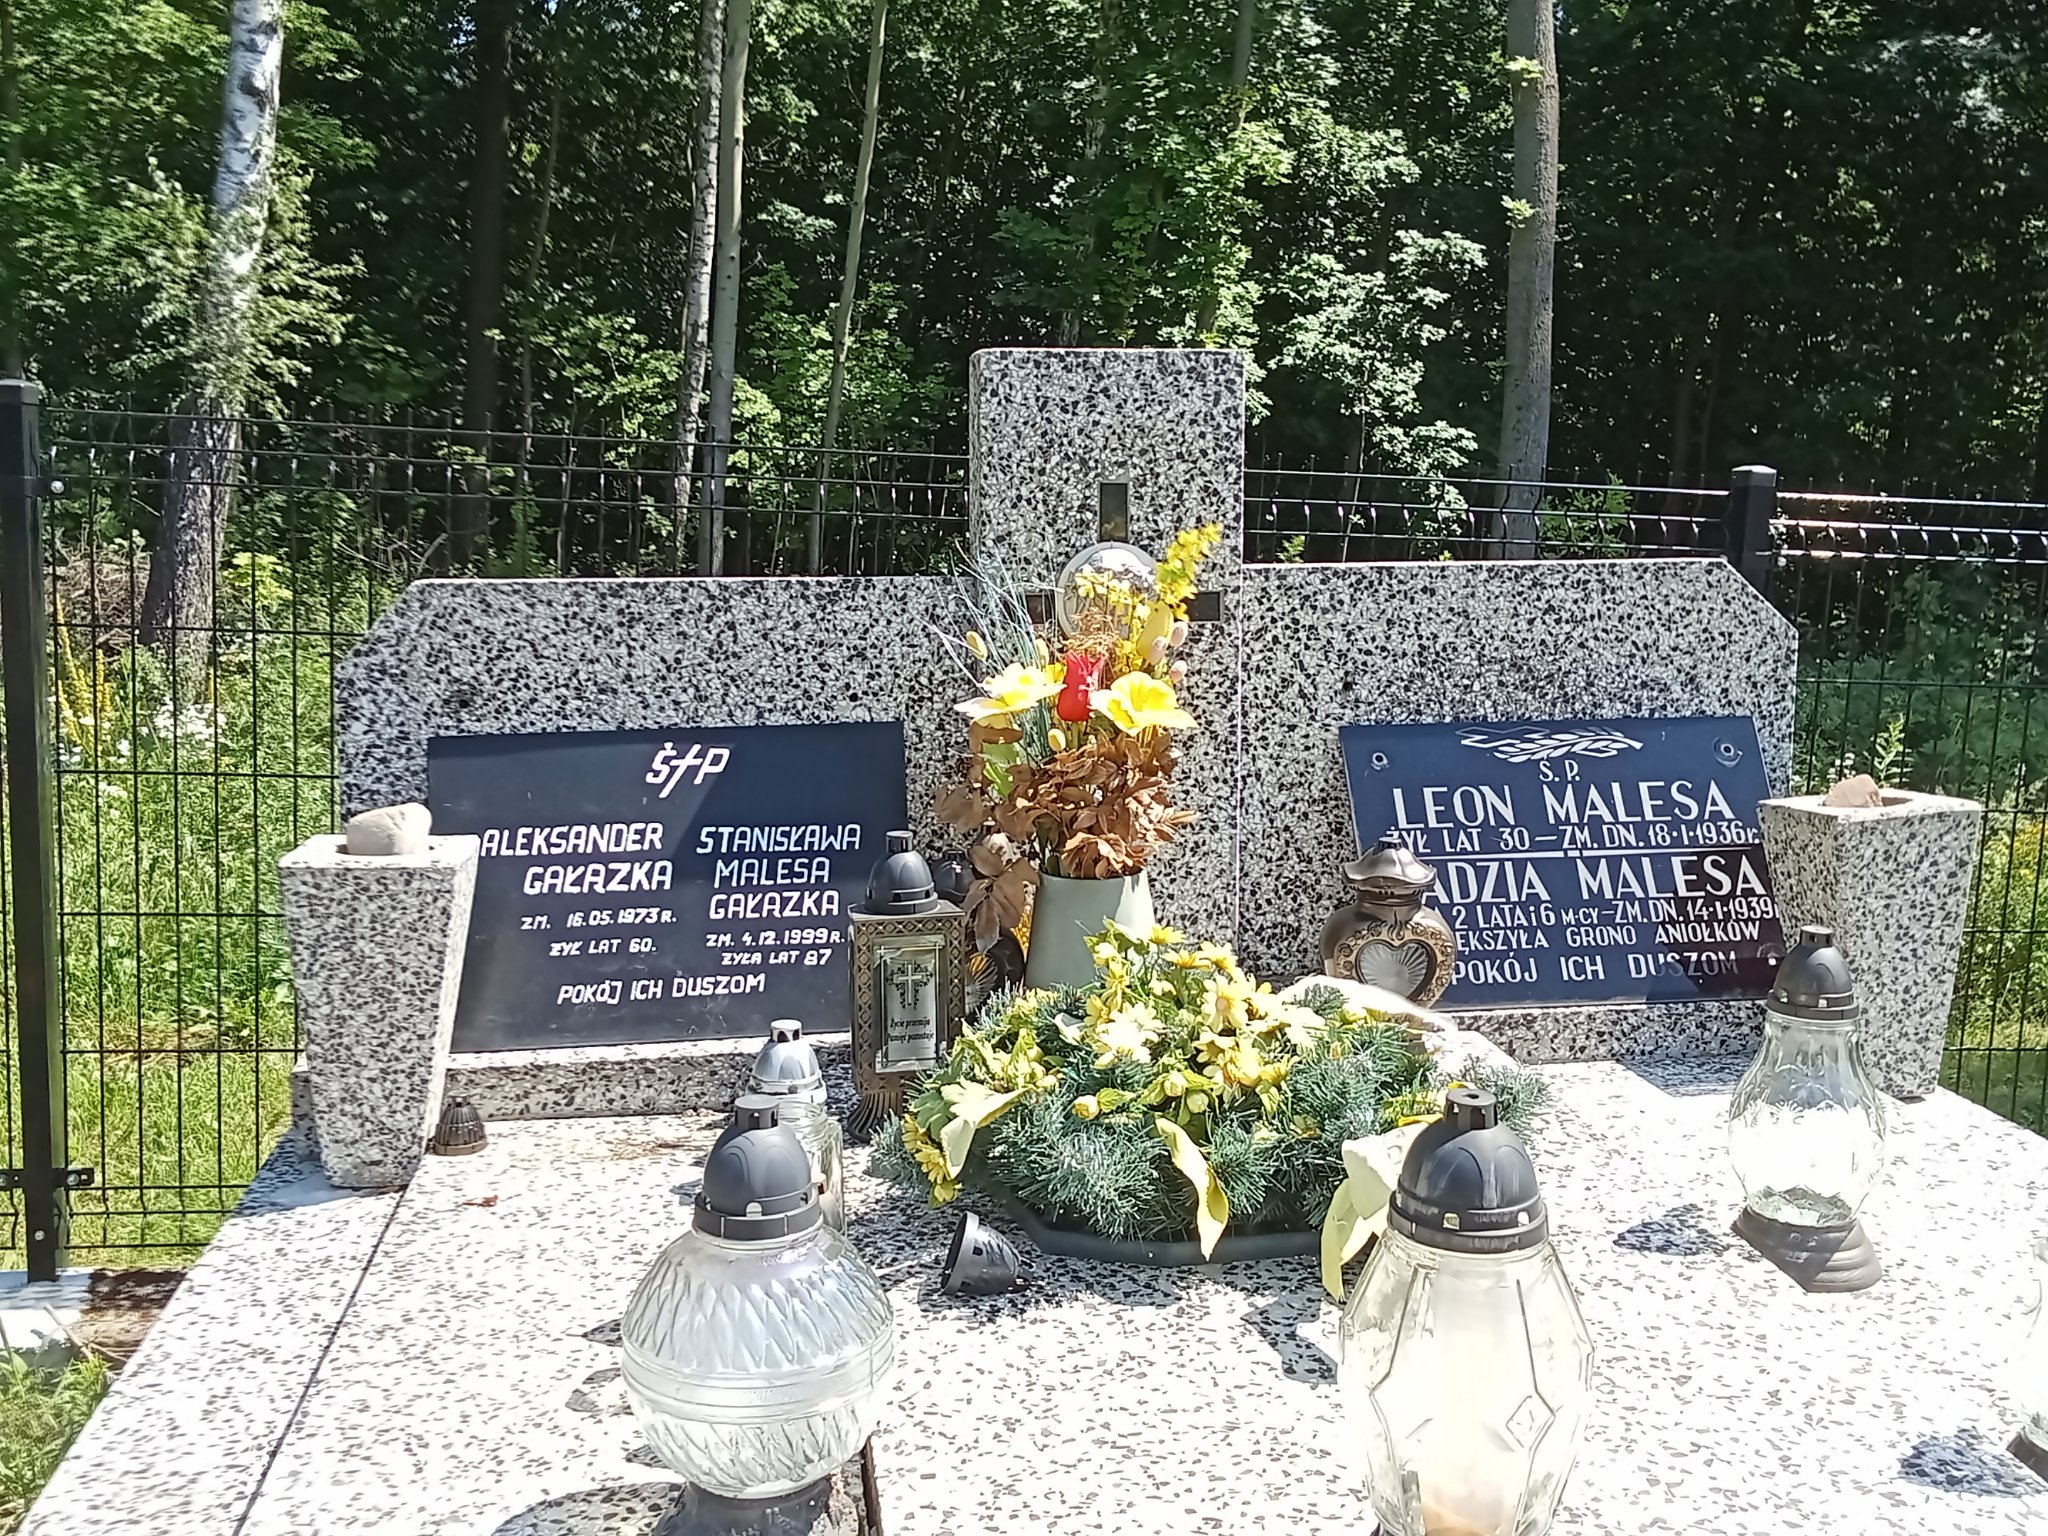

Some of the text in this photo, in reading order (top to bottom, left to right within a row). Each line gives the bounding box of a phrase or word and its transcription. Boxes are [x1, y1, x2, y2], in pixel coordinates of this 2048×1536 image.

[1564, 759, 1581, 782] P.
[1392, 779, 1737, 829] LEON MALESA
[480, 822, 664, 857] ALEKSANDER
[696, 823, 862, 854] STANISŁAWA
[1442, 828, 1482, 853] LAT
[1500, 827, 1530, 851] 30
[1602, 823, 1645, 848] DN.
[713, 856, 831, 889] MALESA
[1421, 854, 1768, 904] ADZIA MALESA
[520, 915, 551, 930] ZM.
[1452, 905, 1468, 930] 2
[1476, 903, 1529, 929] LATA
[1540, 903, 1555, 926] 6
[1648, 898, 1684, 923] DN.
[588, 938, 622, 955] LAT
[628, 937, 657, 953] 60.
[706, 932, 735, 948] ZM.
[1565, 924, 1637, 948] GRONO
[1655, 919, 1760, 945] ANIOŁKÓW
[768, 950, 800, 964] LAT
[803, 948, 832, 966] 87
[1452, 950, 1739, 985] POKÓJ ICH DUSZOM
[557, 973, 766, 1005] POKÓJ ICH DUSZOM
